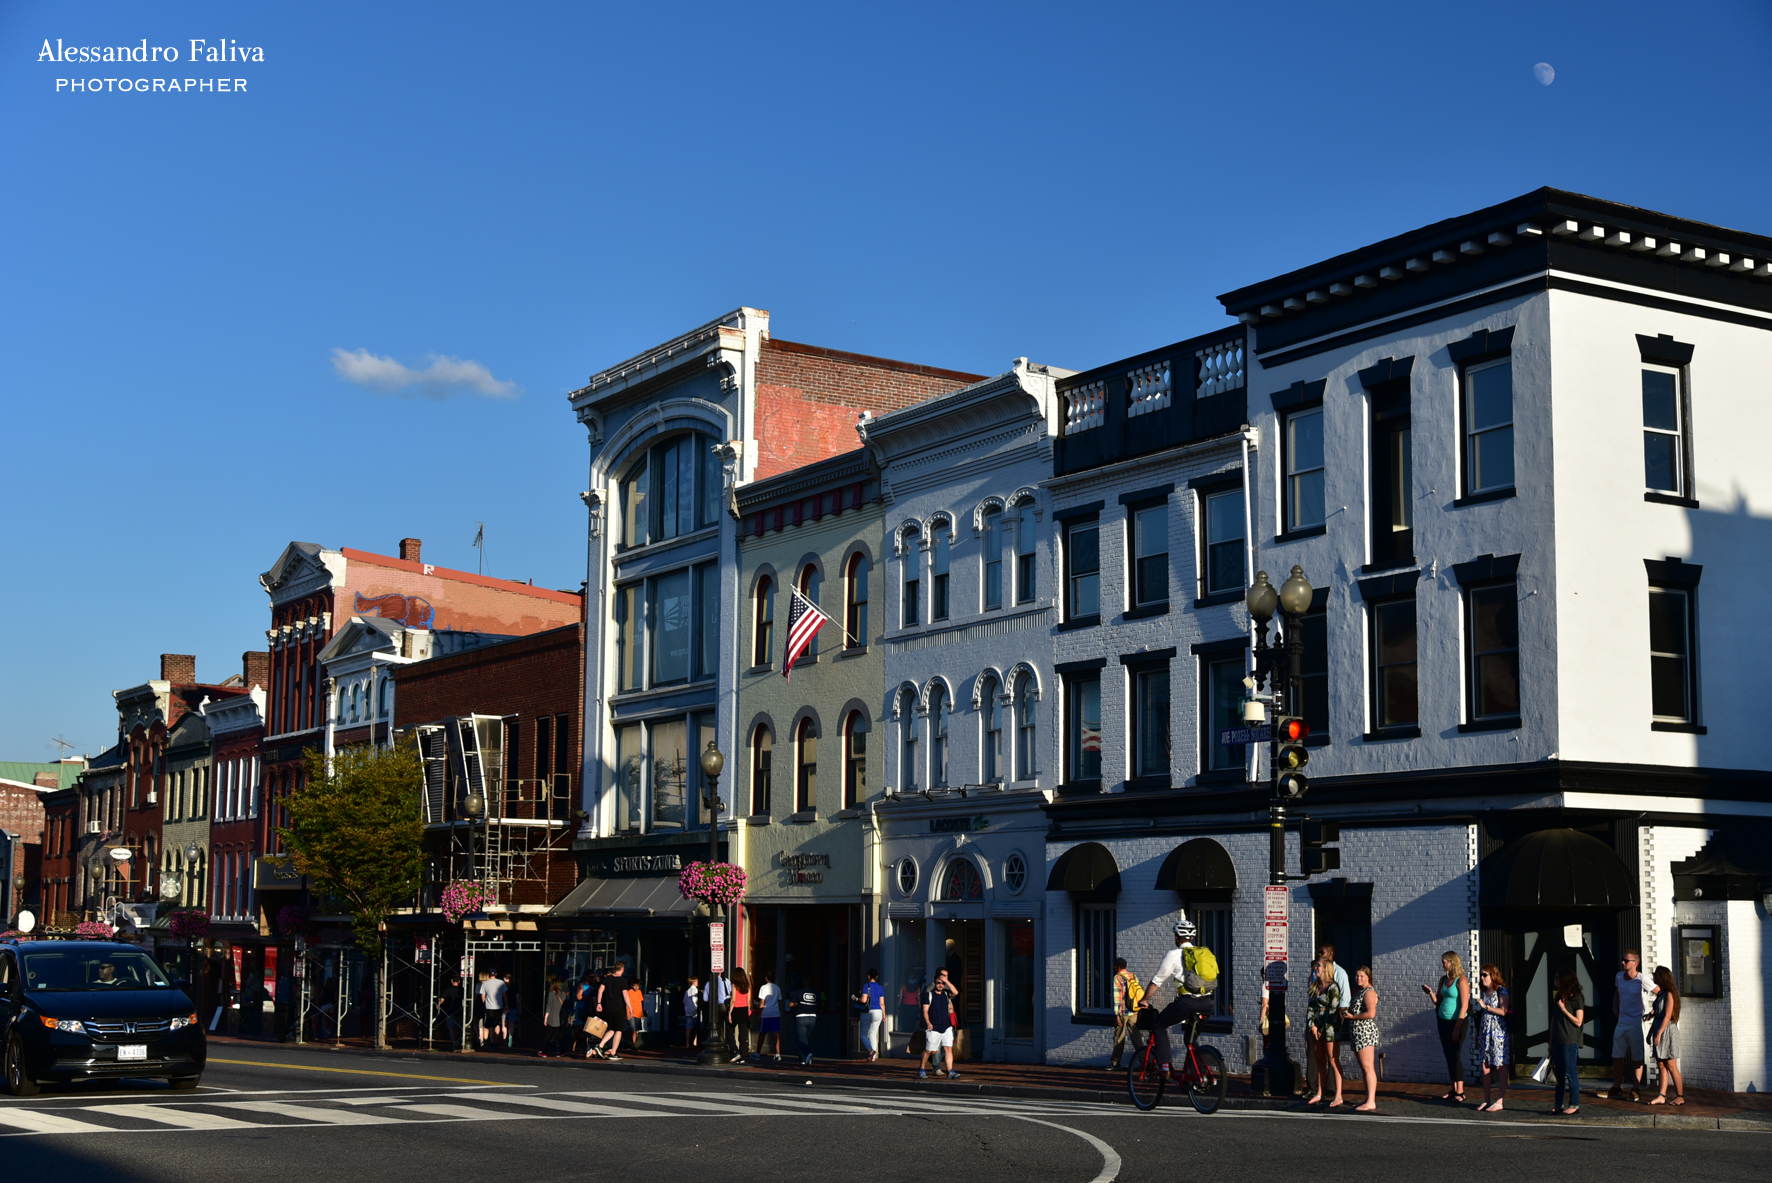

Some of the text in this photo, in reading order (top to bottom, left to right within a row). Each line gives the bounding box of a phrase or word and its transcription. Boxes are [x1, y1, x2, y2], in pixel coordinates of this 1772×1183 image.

[1221, 730, 1231, 745] JOE
[929, 817, 971, 833] LACOSTE
[613, 855, 652, 873] SPORTS
[652, 854, 682, 871] ZONE
[779, 850, 831, 870] Georgetown
[786, 867, 824, 885] Tobacco
